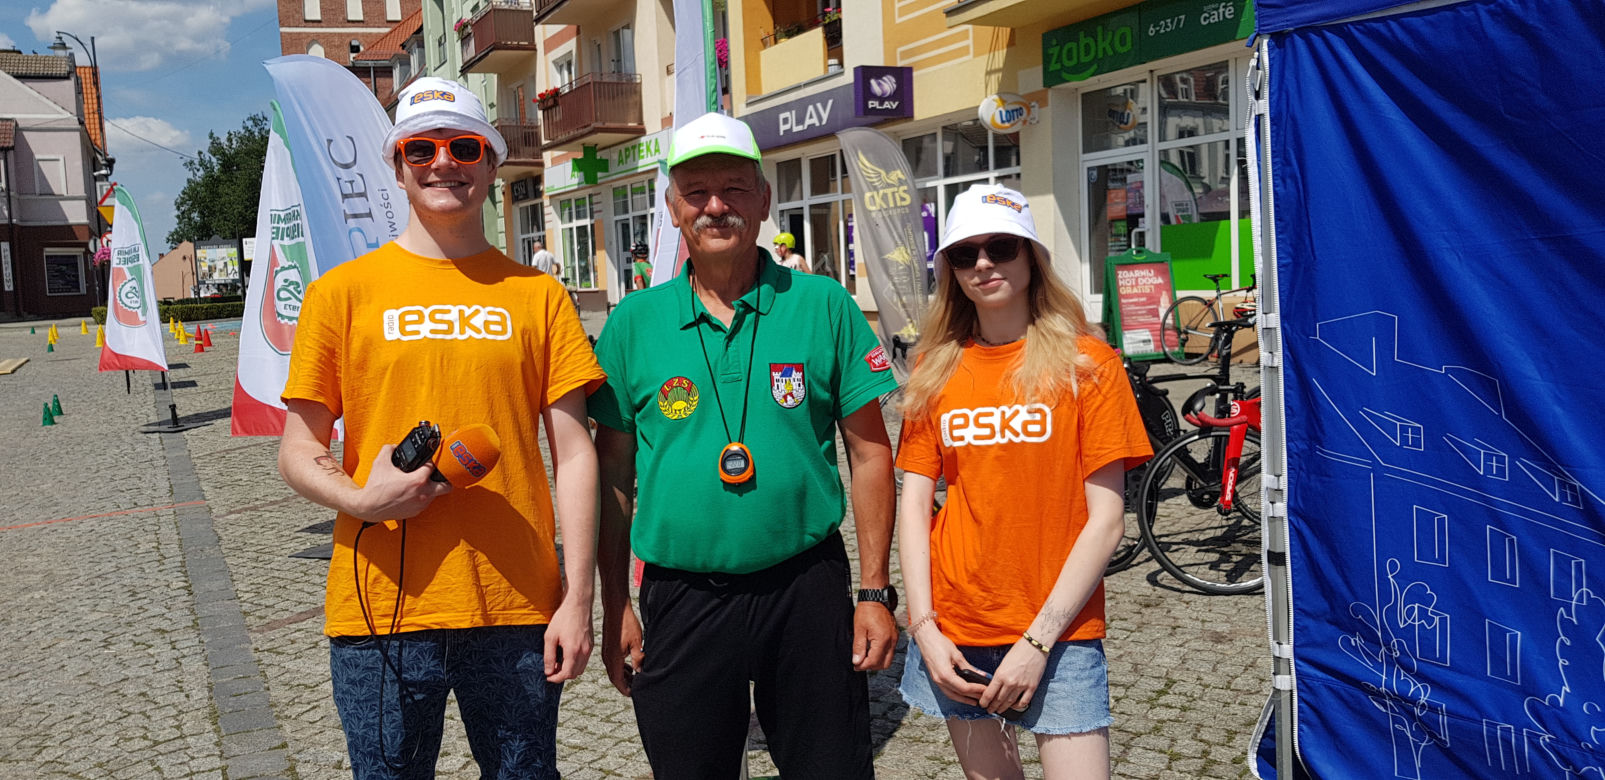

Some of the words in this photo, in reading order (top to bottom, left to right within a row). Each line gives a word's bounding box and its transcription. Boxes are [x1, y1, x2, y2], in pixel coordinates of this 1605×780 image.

[1200, 2, 1235, 25] café
[1148, 14, 1186, 37] 6-23/7
[1048, 25, 1132, 72] żabka
[413, 90, 455, 104] eska
[868, 100, 899, 110] PLAY
[779, 99, 834, 136] PLAY
[999, 106, 1024, 124] LOTTO
[617, 137, 661, 167] APTEKA
[1117, 269, 1154, 279] ZGARNIJ
[1119, 277, 1137, 286] HOT
[1138, 276, 1164, 285] DOGA
[398, 306, 511, 339] eska
[663, 378, 689, 391] LZS
[949, 406, 1050, 444] eska
[452, 444, 486, 478] eska
